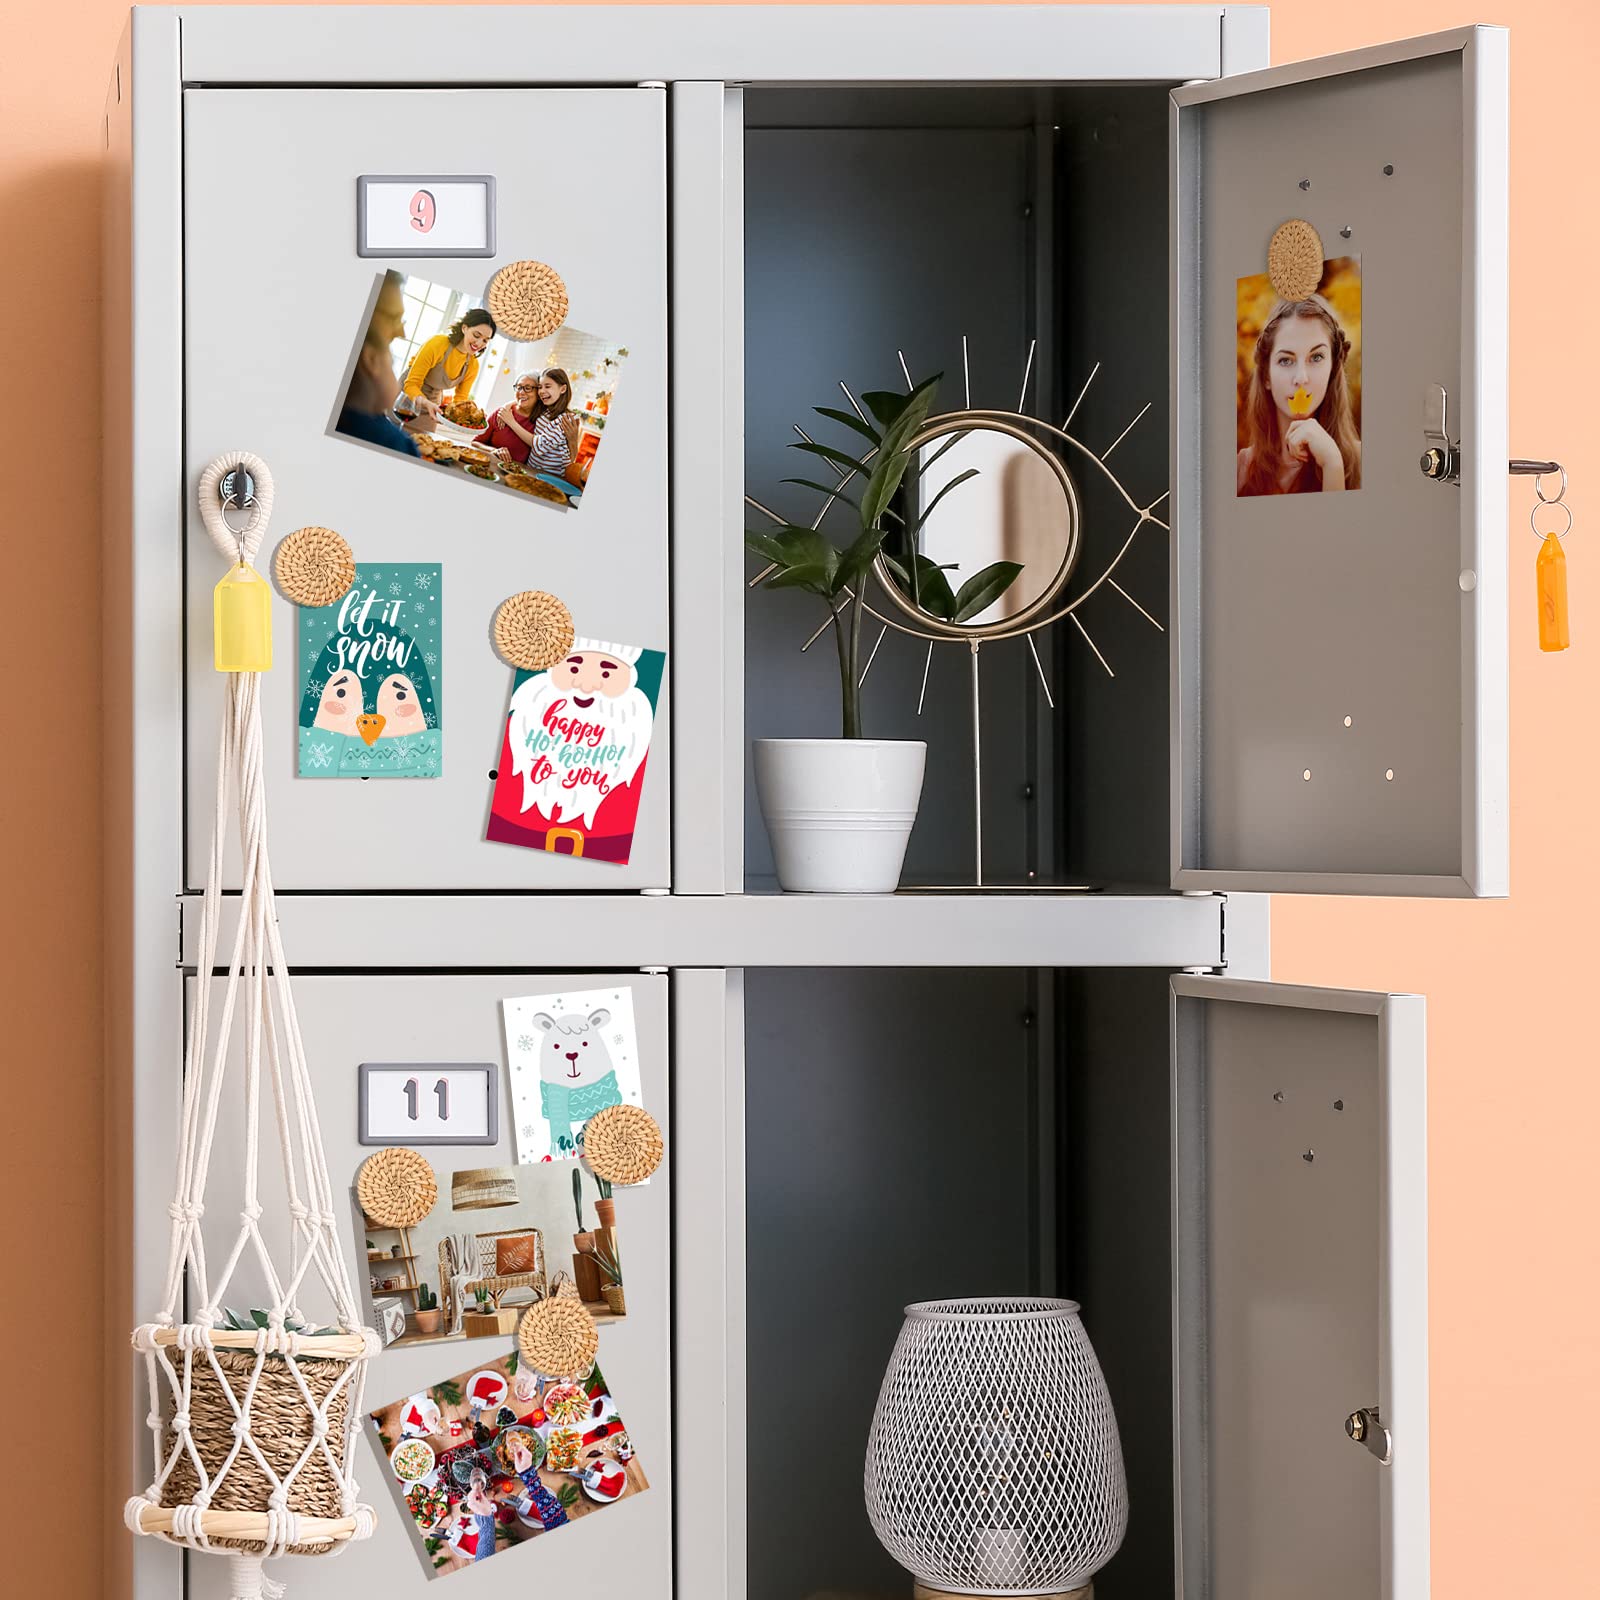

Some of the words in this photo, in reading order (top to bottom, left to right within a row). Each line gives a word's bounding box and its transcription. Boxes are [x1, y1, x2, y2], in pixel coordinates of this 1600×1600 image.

[410, 189, 436, 233] 9
[337, 589, 384, 637] let
[326, 632, 415, 679] snow
[542, 698, 606, 748] happy
[530, 754, 558, 785] to
[561, 767, 610, 795] you
[403, 1077, 449, 1121] 11
